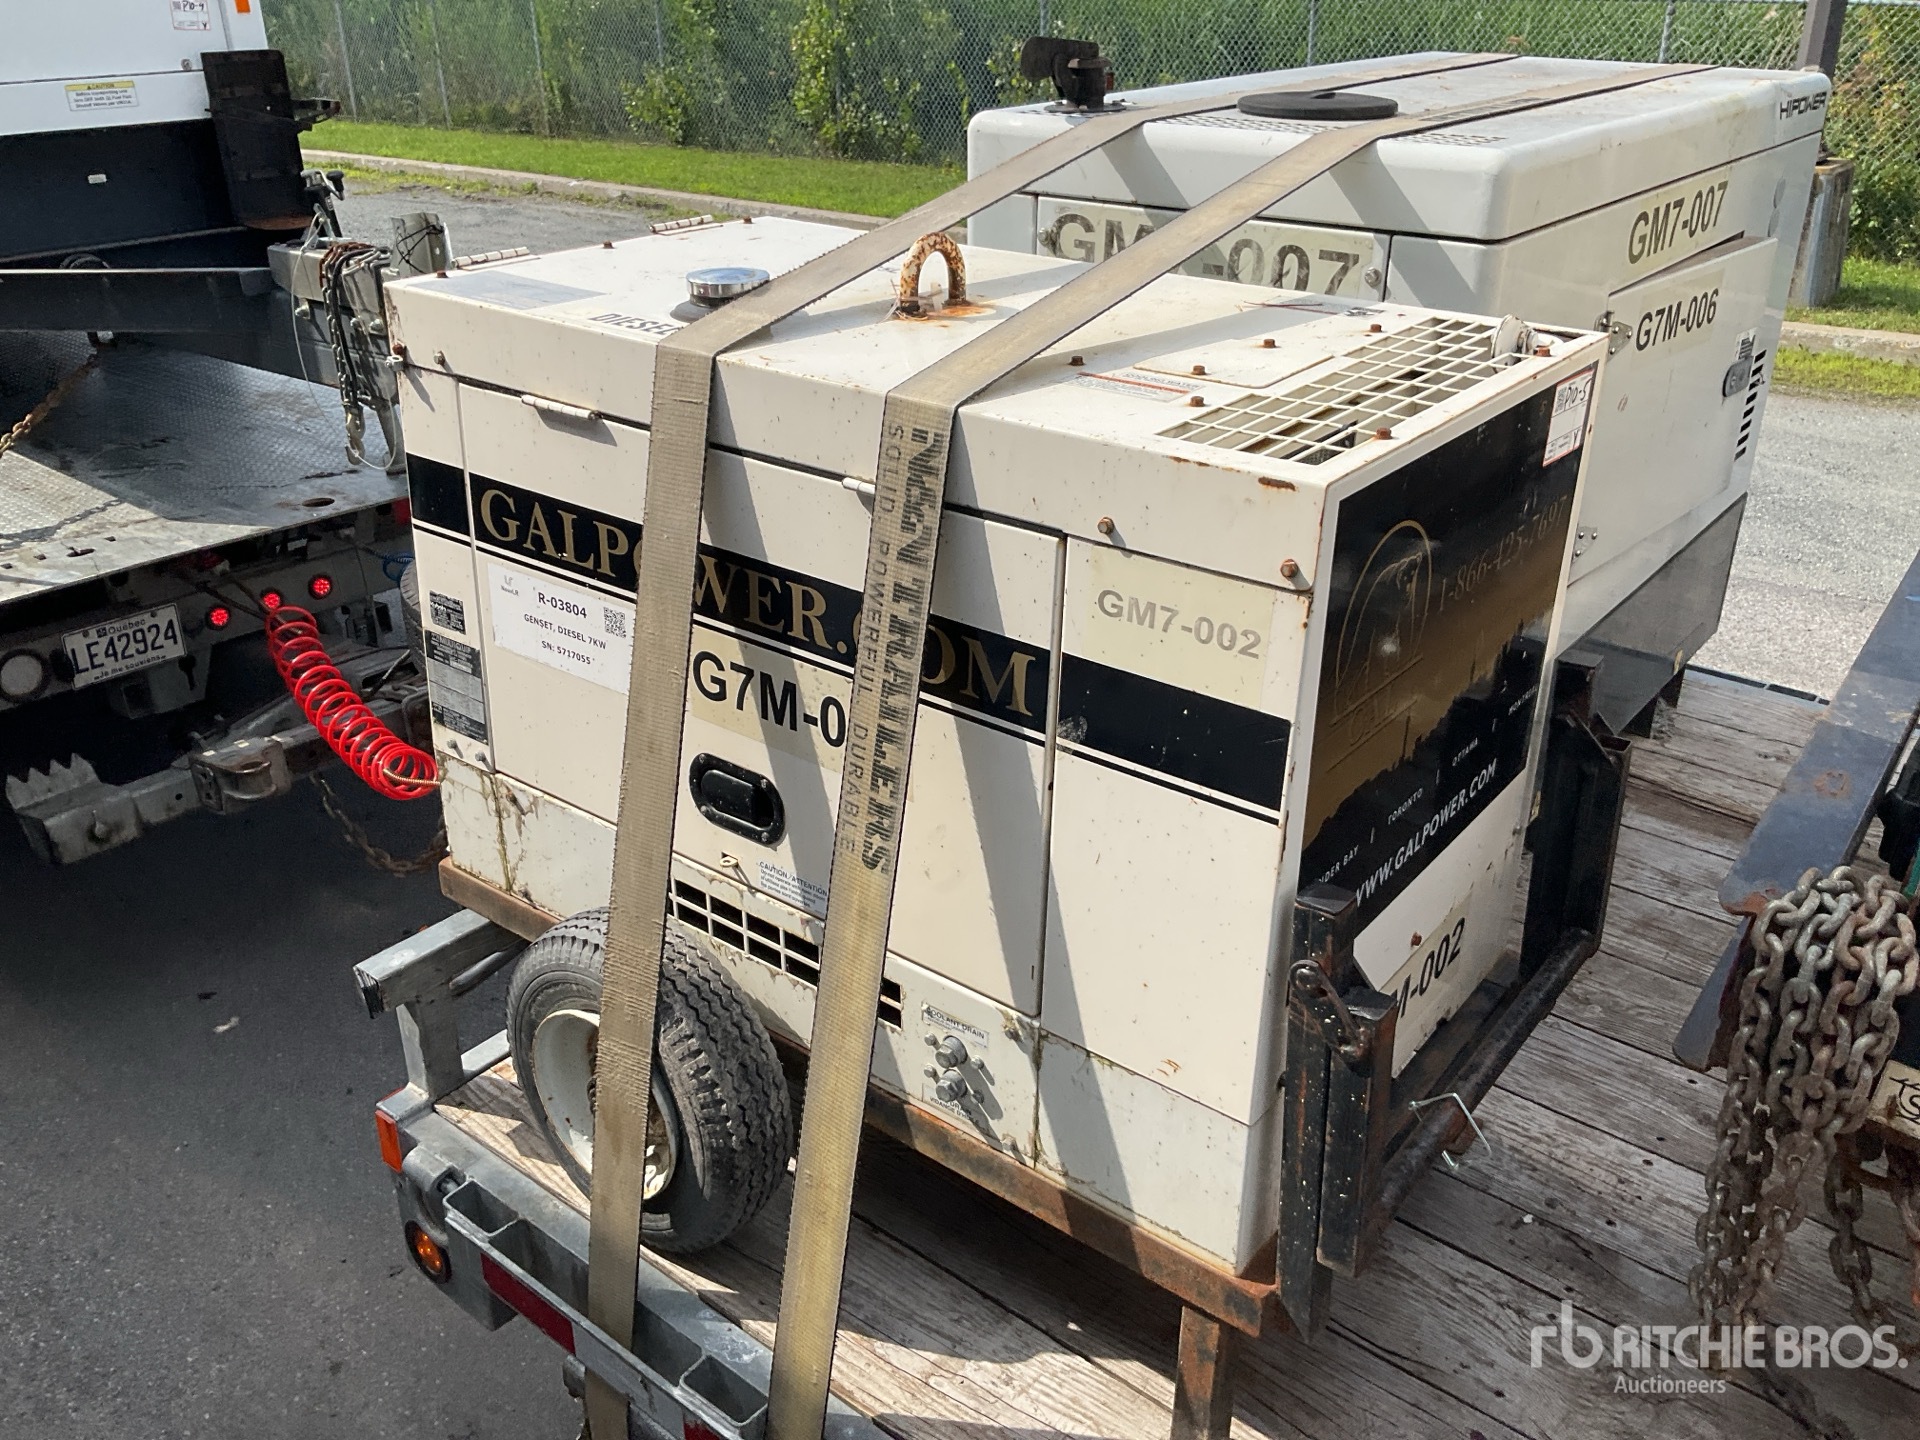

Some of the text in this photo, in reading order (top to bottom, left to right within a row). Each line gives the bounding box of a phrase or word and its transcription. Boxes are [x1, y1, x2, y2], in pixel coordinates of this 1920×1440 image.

[1779, 91, 1827, 120] HIPOWER
[1628, 180, 1729, 265] GM7-007
[1049, 213, 1361, 296] GM-007
[1635, 288, 1720, 352] G7M-006
[524, 613, 607, 650] GENSET, DIESEL 7KW
[538, 591, 587, 619] R-03804
[1097, 589, 1262, 660] GM7-002
[71, 619, 178, 675] LE42924
[541, 640, 591, 665] SN: 5717055
[861, 577, 926, 875] TRAILERS
[1388, 787, 1423, 825] TORONTO
